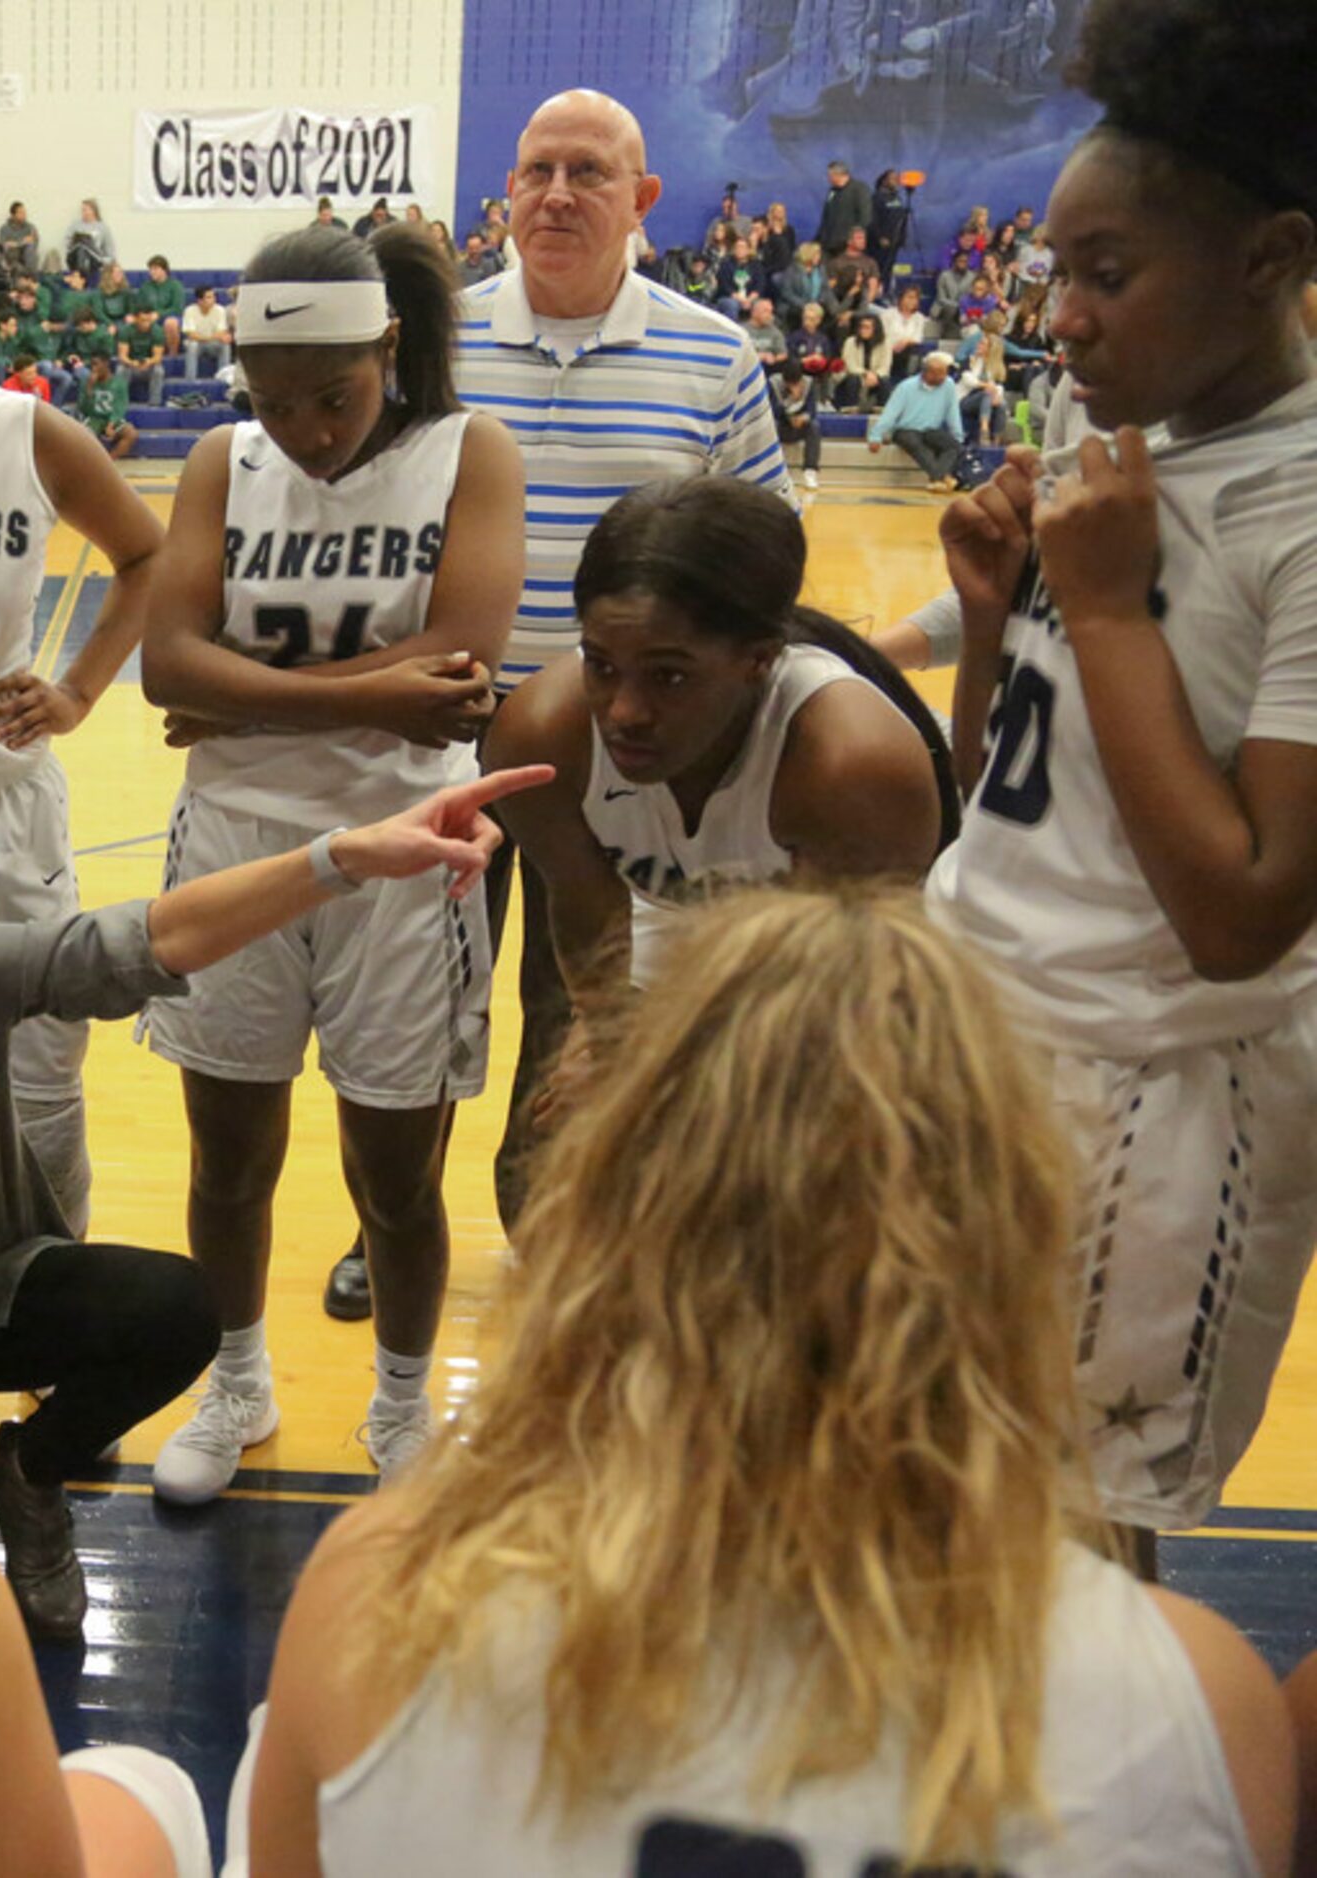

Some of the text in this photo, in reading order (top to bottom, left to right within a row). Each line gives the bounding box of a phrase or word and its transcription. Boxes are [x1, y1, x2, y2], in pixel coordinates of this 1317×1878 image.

[152, 116, 414, 200] Class of 2021
[225, 522, 443, 580] RANGERS
